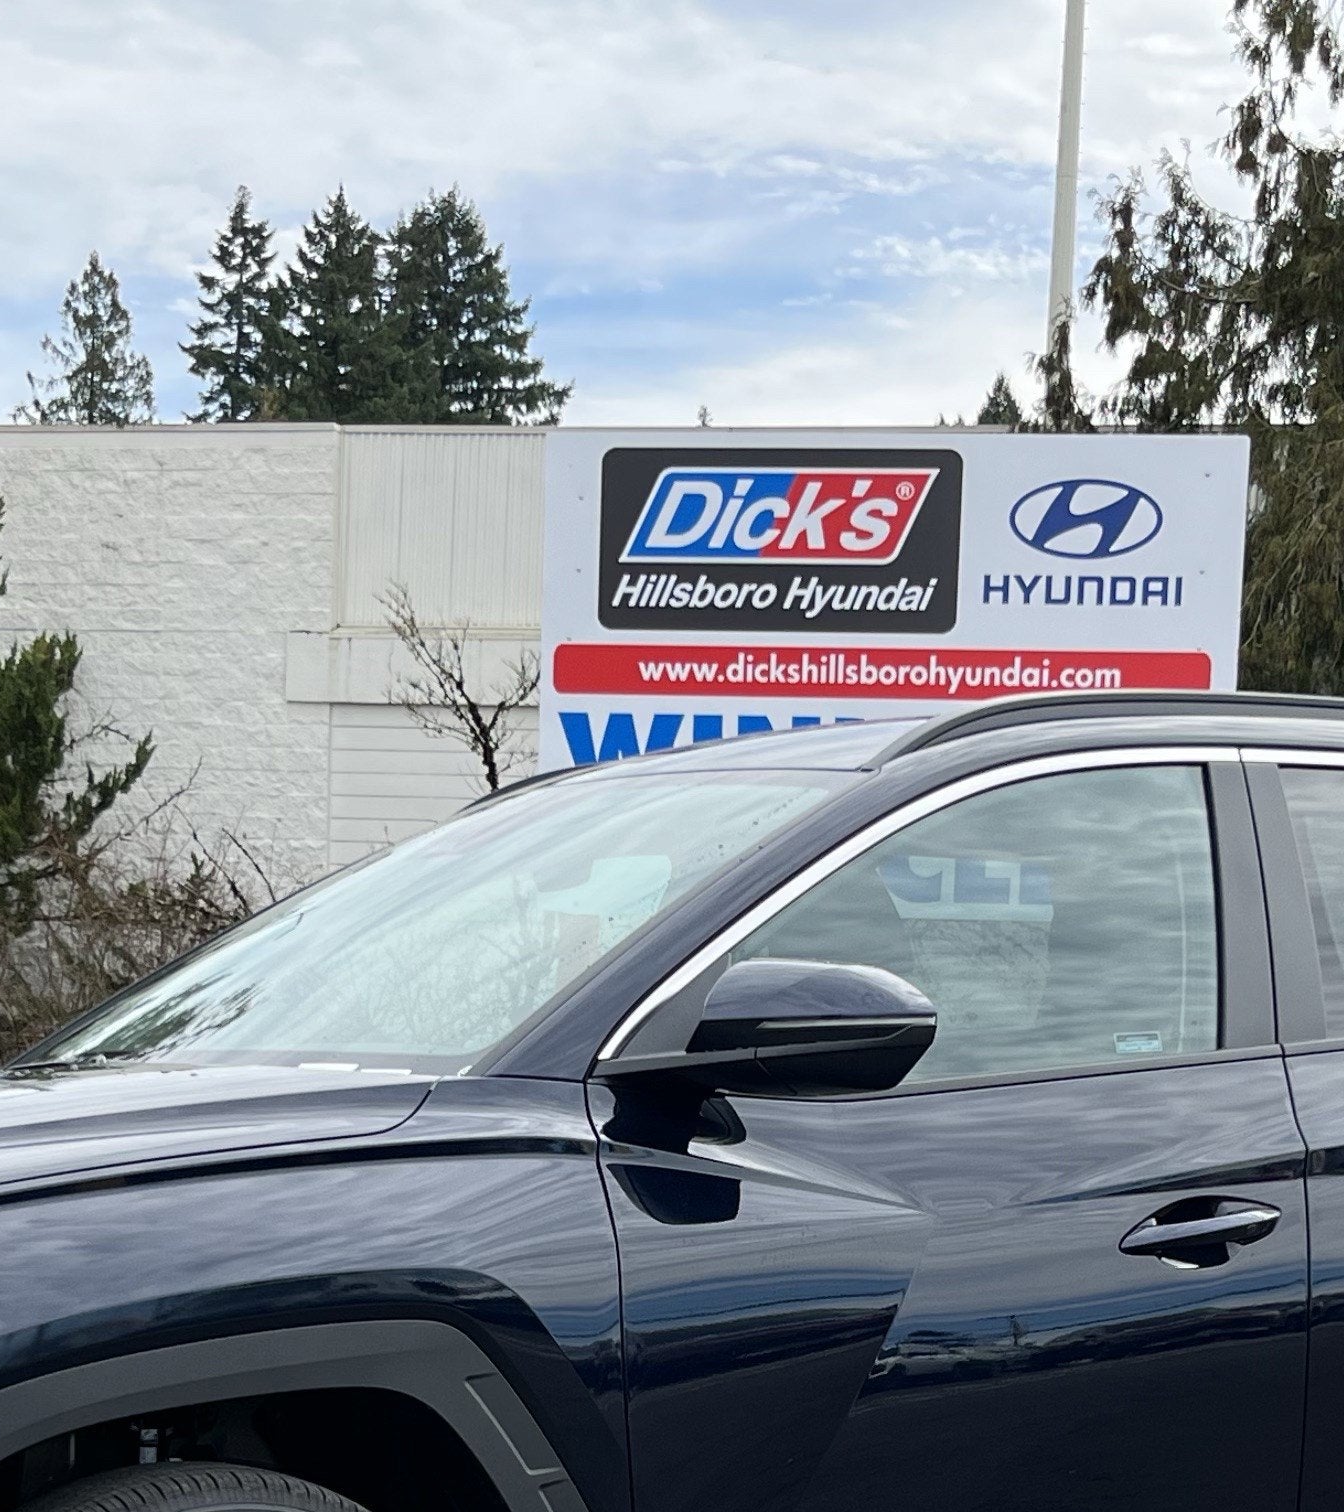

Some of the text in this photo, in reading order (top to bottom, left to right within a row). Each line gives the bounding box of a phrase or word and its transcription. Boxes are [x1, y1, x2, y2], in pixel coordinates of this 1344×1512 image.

[644, 478, 899, 551] Dick's
[611, 574, 938, 618] Hillsboro Hyundai
[982, 575, 1183, 607] HYUNDAI
[638, 653, 1122, 694] www.dickshillsborohyundai.com
